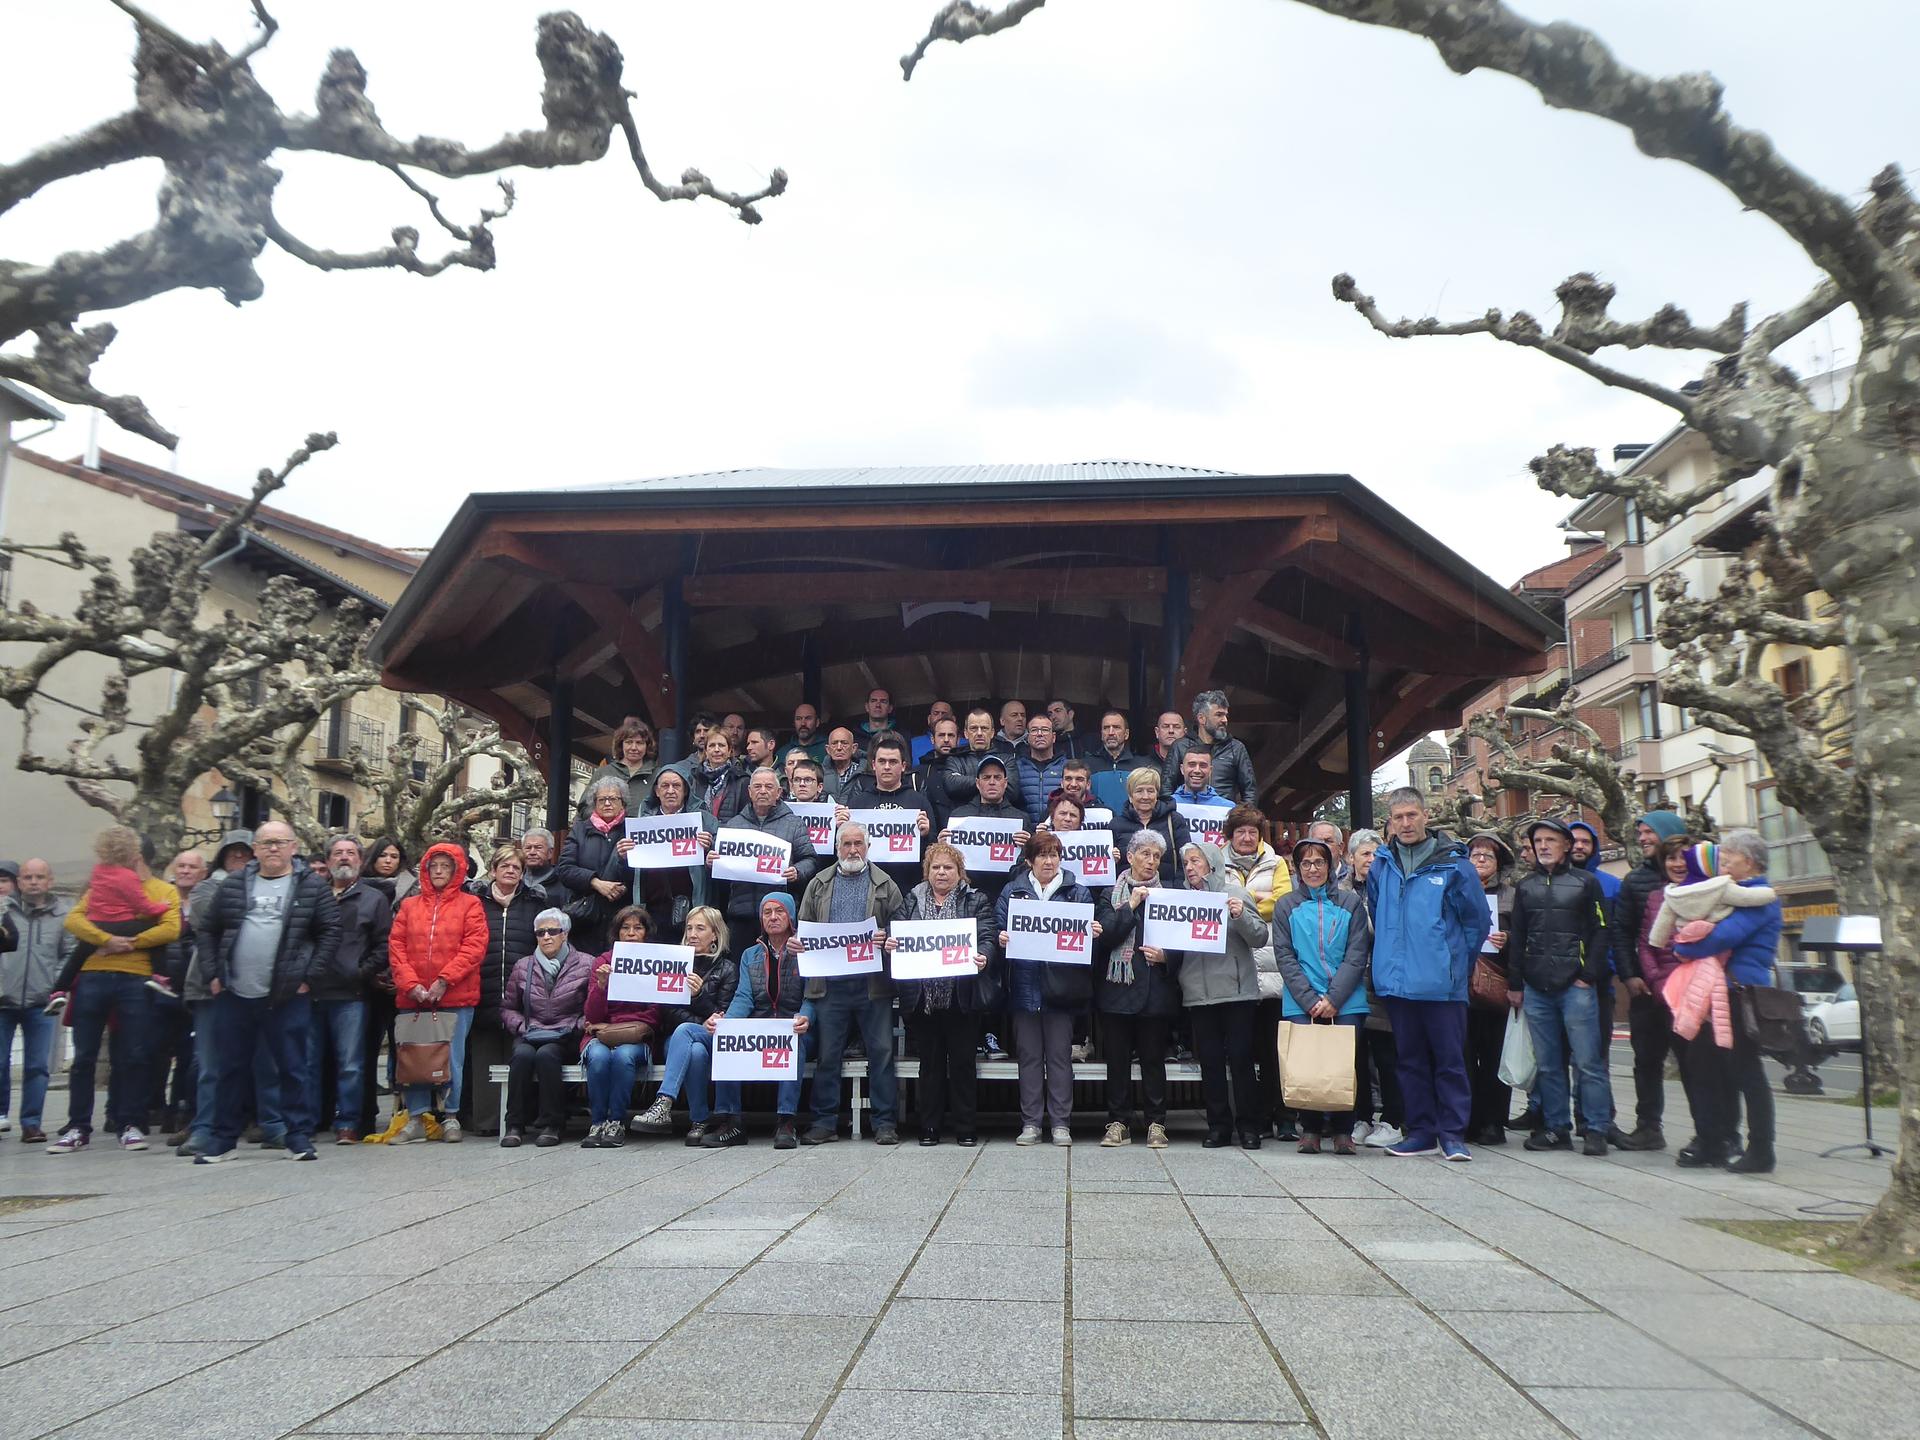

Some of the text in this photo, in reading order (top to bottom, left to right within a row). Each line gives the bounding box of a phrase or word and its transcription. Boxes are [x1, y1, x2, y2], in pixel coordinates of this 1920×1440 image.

[799, 816, 832, 829] ORIK
[868, 823, 916, 838] ASORIK
[630, 826, 698, 845] ERASORIK
[889, 835, 912, 851] EZ!
[672, 839, 697, 856] EZ!
[719, 841, 786, 861] ERASORIK
[990, 843, 1014, 861] EZ!
[1061, 844, 1110, 861] ASORIK
[756, 855, 782, 874] EZ!
[1083, 857, 1108, 875] EZ!
[1149, 904, 1223, 925] ERASORIK
[1012, 915, 1088, 935] ERASORIK
[1192, 921, 1218, 940] EZ!
[800, 930, 873, 951] ERASORIK
[896, 933, 972, 952] ERASORIK
[1057, 931, 1084, 951] EZ!
[847, 943, 874, 962] EZ!
[942, 946, 969, 965] EZ!
[614, 958, 688, 975] ERASORIK
[657, 973, 684, 992] EZ!
[717, 1035, 793, 1052] ERASORIK
[762, 1049, 789, 1068] EZ!
